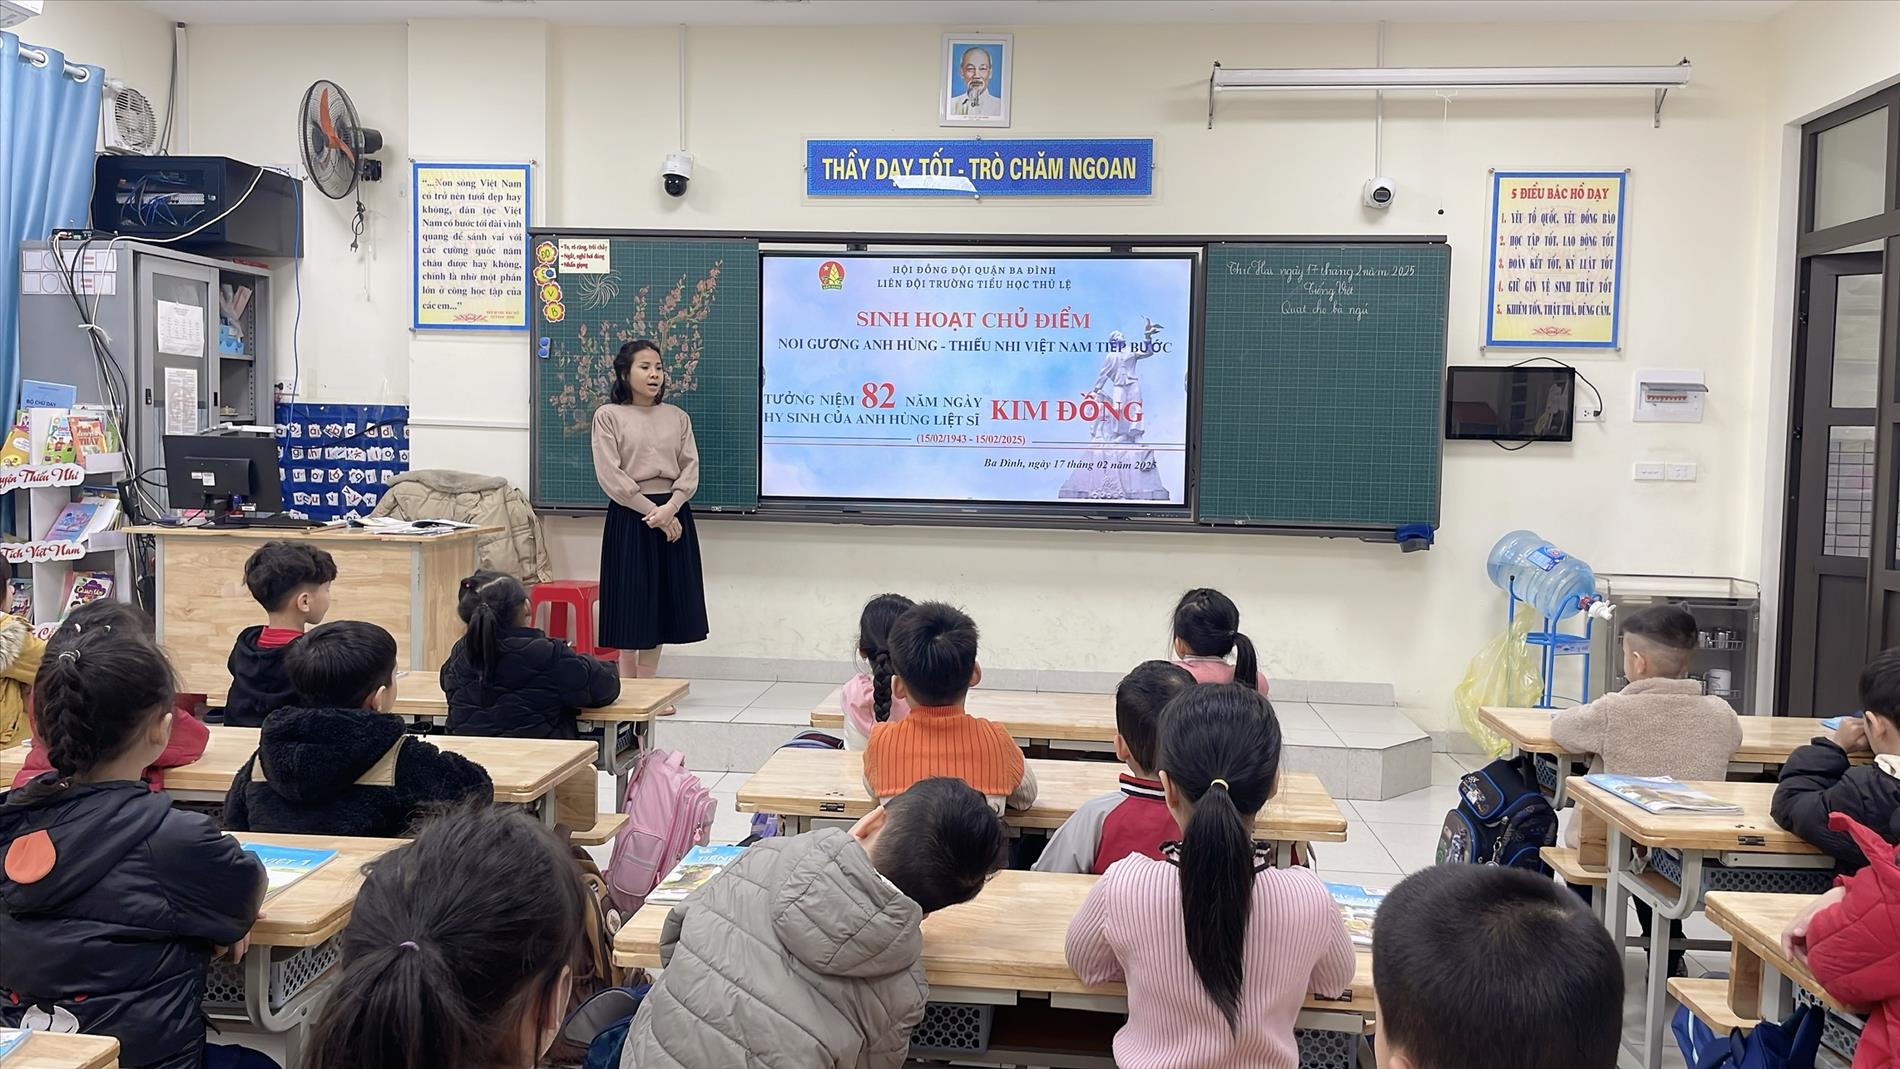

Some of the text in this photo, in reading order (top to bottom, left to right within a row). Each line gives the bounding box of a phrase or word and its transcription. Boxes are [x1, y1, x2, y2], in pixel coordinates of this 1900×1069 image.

[822, 148, 1136, 186] THẦY DẠY TỐT TRÒ CHĂM NGOAN
[507, 194, 521, 203] hay
[1512, 182, 1609, 202] 5 ĐIỀU BÁC HỒ DẠY
[423, 219, 442, 227] Nam
[503, 220, 521, 228] vinh
[1510, 230, 1614, 251] HỌC TẬP LAO ĐỘNG TỐT
[422, 246, 436, 254] các
[473, 260, 487, 269] hay
[1508, 255, 1526, 269] ĐOÀN
[1530, 253, 1543, 269] KẾT
[1600, 254, 1613, 270] TỐT
[422, 272, 445, 280] chính
[892, 264, 1056, 276] HỘI ĐỒNG ĐỘI QUẬN BA ĐÌNH
[1251, 260, 1274, 275] Hai
[1280, 266, 1304, 283] ngày
[1391, 265, 1415, 277] 2025
[877, 275, 1072, 291] LIÊN ĐỘI TRƯỜNG TIỂU HỌC THỦ LỆ
[1541, 278, 1550, 296] VỆ
[1555, 282, 1571, 292] SINH
[1576, 279, 1594, 296] THẬT
[1600, 276, 1612, 293] TỐT
[422, 301, 436, 309] các
[1312, 300, 1327, 314] cho
[1332, 301, 1343, 314] bà
[856, 305, 1090, 331] SINH HOẠT CHỦ ĐIỂM
[808, 338, 859, 350] GƯƠNG
[863, 340, 893, 350] ANH
[897, 337, 937, 351] HÙNG
[950, 337, 991, 351] THIẾU
[995, 341, 1020, 352] NHI
[1025, 338, 1056, 355] VIỆT
[1059, 341, 1091, 352] NAM
[1095, 336, 1126, 353] TIẾP
[1130, 339, 1172, 353] BƯỚC
[764, 382, 983, 409] TƯỞNG NIỆM 82 NĂM NGÀY
[991, 391, 1143, 423] KIM ĐỒNG
[764, 410, 980, 428] HY SINH CỦA ANH HÙNG LIỆT SĨ
[916, 434, 1026, 446] (15/02/1943 15/02/2025)
[984, 458, 997, 468] Ba
[1028, 459, 1051, 471] ngày
[1054, 459, 1065, 468] 17
[1067, 459, 1094, 471] tháng
[1096, 461, 1108, 469] 02
[1110, 461, 1131, 470] năm
[1134, 461, 1157, 470] 2025
[19, 468, 79, 483] Thiếu Nhi
[47, 546, 80, 556] Nam
